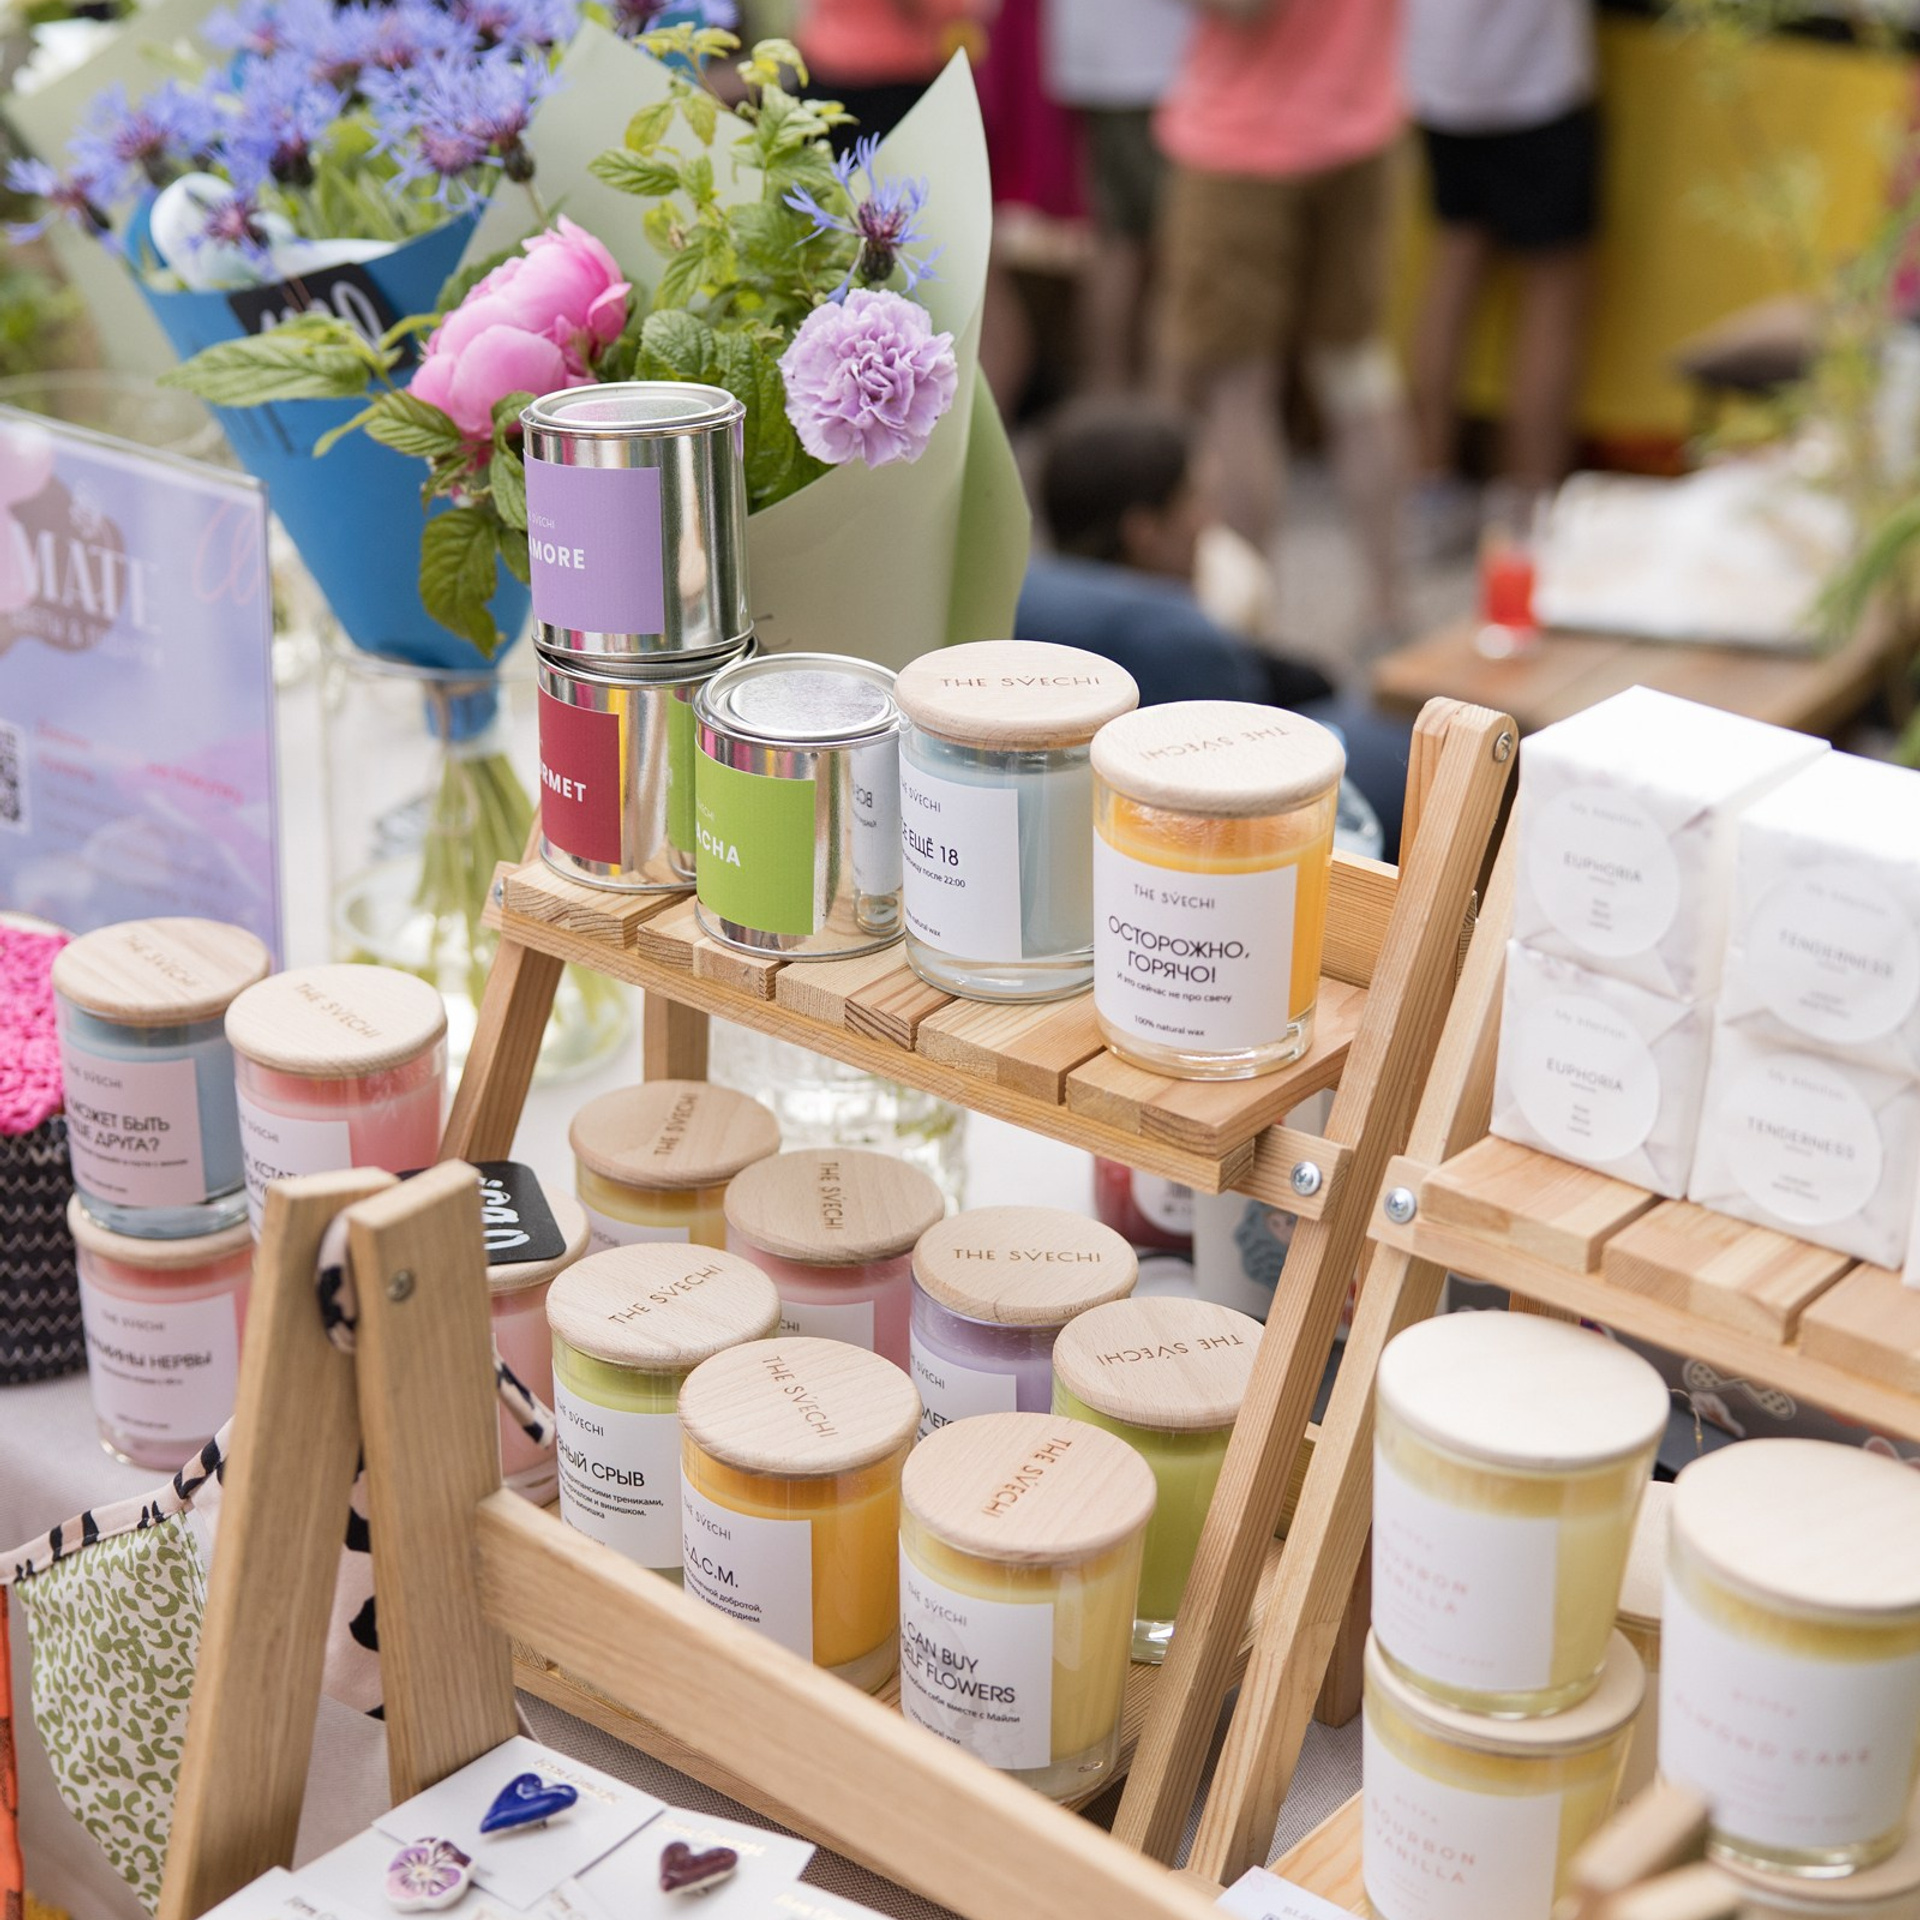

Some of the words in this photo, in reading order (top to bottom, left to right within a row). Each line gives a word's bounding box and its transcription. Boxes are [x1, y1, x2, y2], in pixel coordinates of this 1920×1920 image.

[940, 677, 988, 688] THE
[1240, 726, 1291, 742] THE
[541, 761, 587, 803] RMET
[909, 829, 934, 859] ЕЩЁ
[940, 845, 959, 867] 18
[943, 874, 967, 889] 22:00
[1133, 883, 1155, 901] THE
[1108, 915, 1250, 960] ОСТОРОЖНО,
[1128, 950, 1216, 984] ГОРЯЧО!
[1136, 980, 1167, 998] сейчас
[1168, 989, 1181, 1000] не
[1183, 991, 1202, 1004] про
[1203, 993, 1233, 1005] свечу
[1134, 1015, 1155, 1029] 100%
[1156, 1021, 1186, 1036] natural
[1187, 1027, 1206, 1037] wax
[122, 1114, 171, 1132] БЫТЬ
[94, 1131, 160, 1152] ДРУГА?
[653, 1136, 680, 1155] THE
[820, 1161, 840, 1181] THE
[952, 1248, 996, 1261] THE
[607, 1302, 651, 1324] THE
[1197, 1334, 1244, 1350] THE
[762, 1355, 796, 1382] THE
[1034, 1437, 1073, 1464] THE
[591, 1461, 645, 1488] СРЫВ
[600, 1501, 647, 1518] винишком.
[612, 1494, 664, 1508] трениками,
[705, 1597, 761, 1624] милосердием
[907, 1621, 937, 1659] CAN
[942, 1647, 979, 1674] BUY
[926, 1662, 1016, 1704] FLOWERS
[986, 1713, 1021, 1724] Майли
